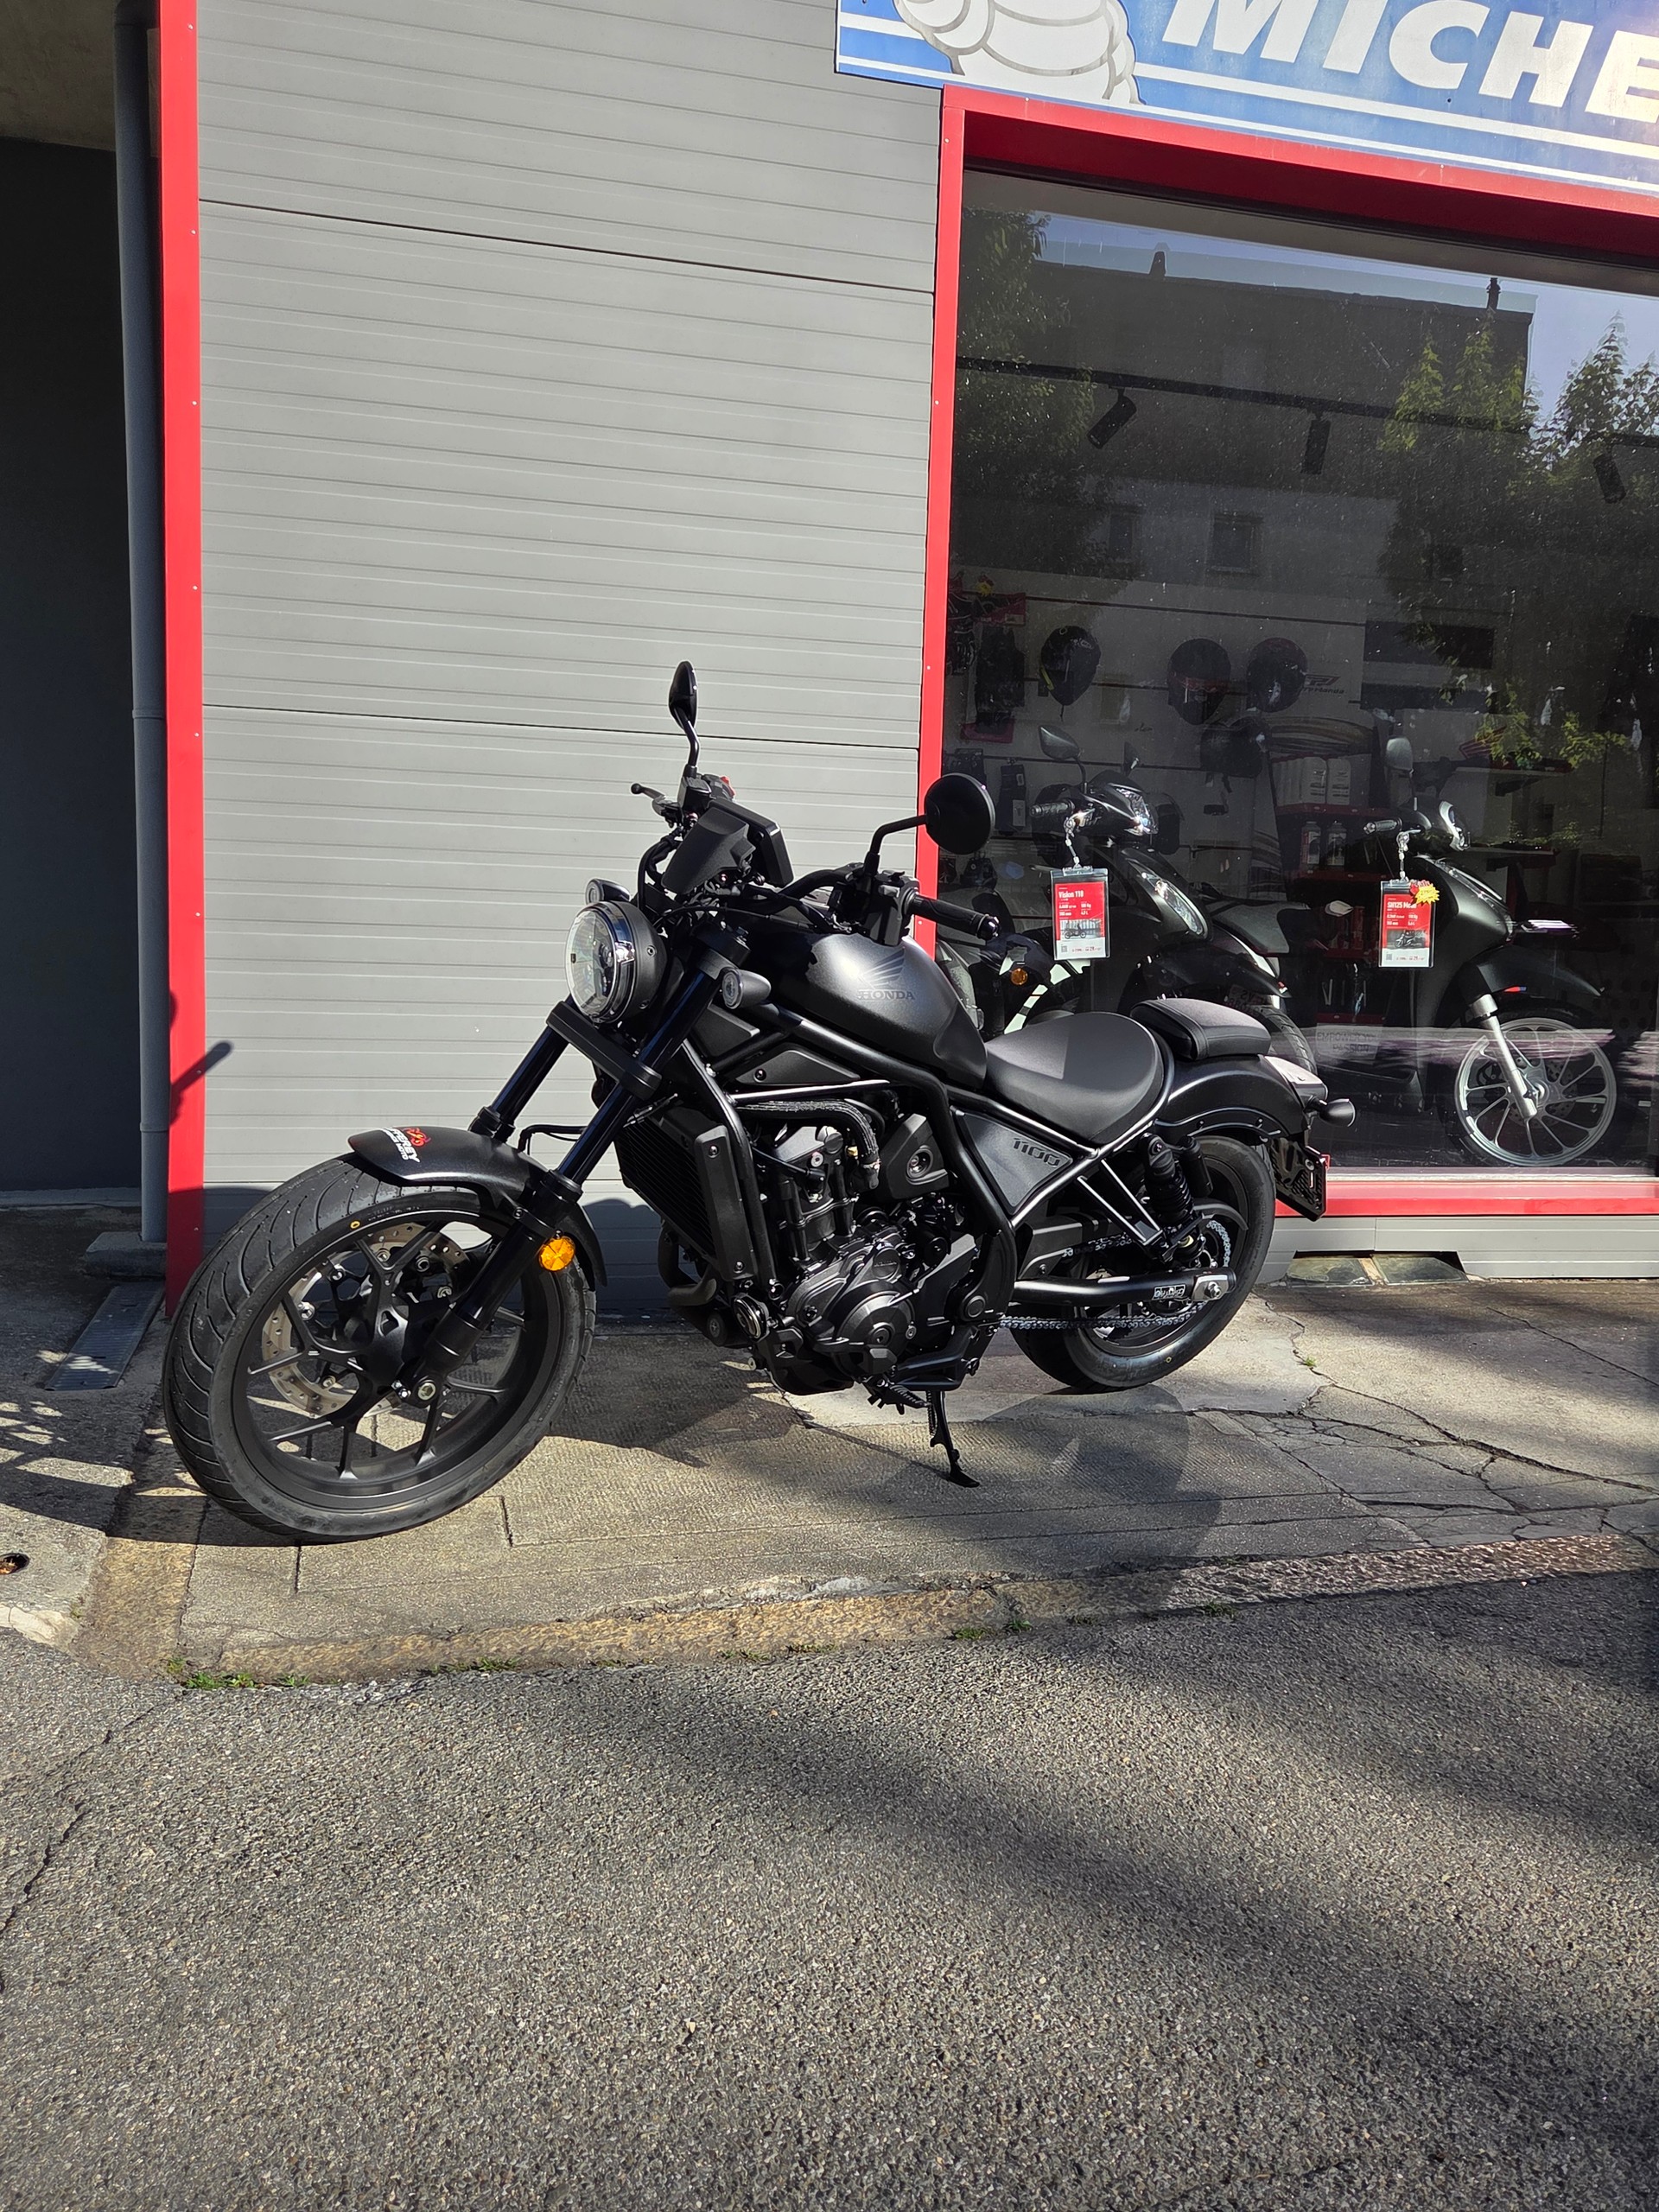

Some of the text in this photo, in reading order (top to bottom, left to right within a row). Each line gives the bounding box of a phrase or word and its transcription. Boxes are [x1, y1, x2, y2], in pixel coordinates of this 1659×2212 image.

[857, 990, 916, 1001] HONDA
[1332, 1043, 1370, 1052] PASSION
[1013, 1137, 1061, 1166] 1100
